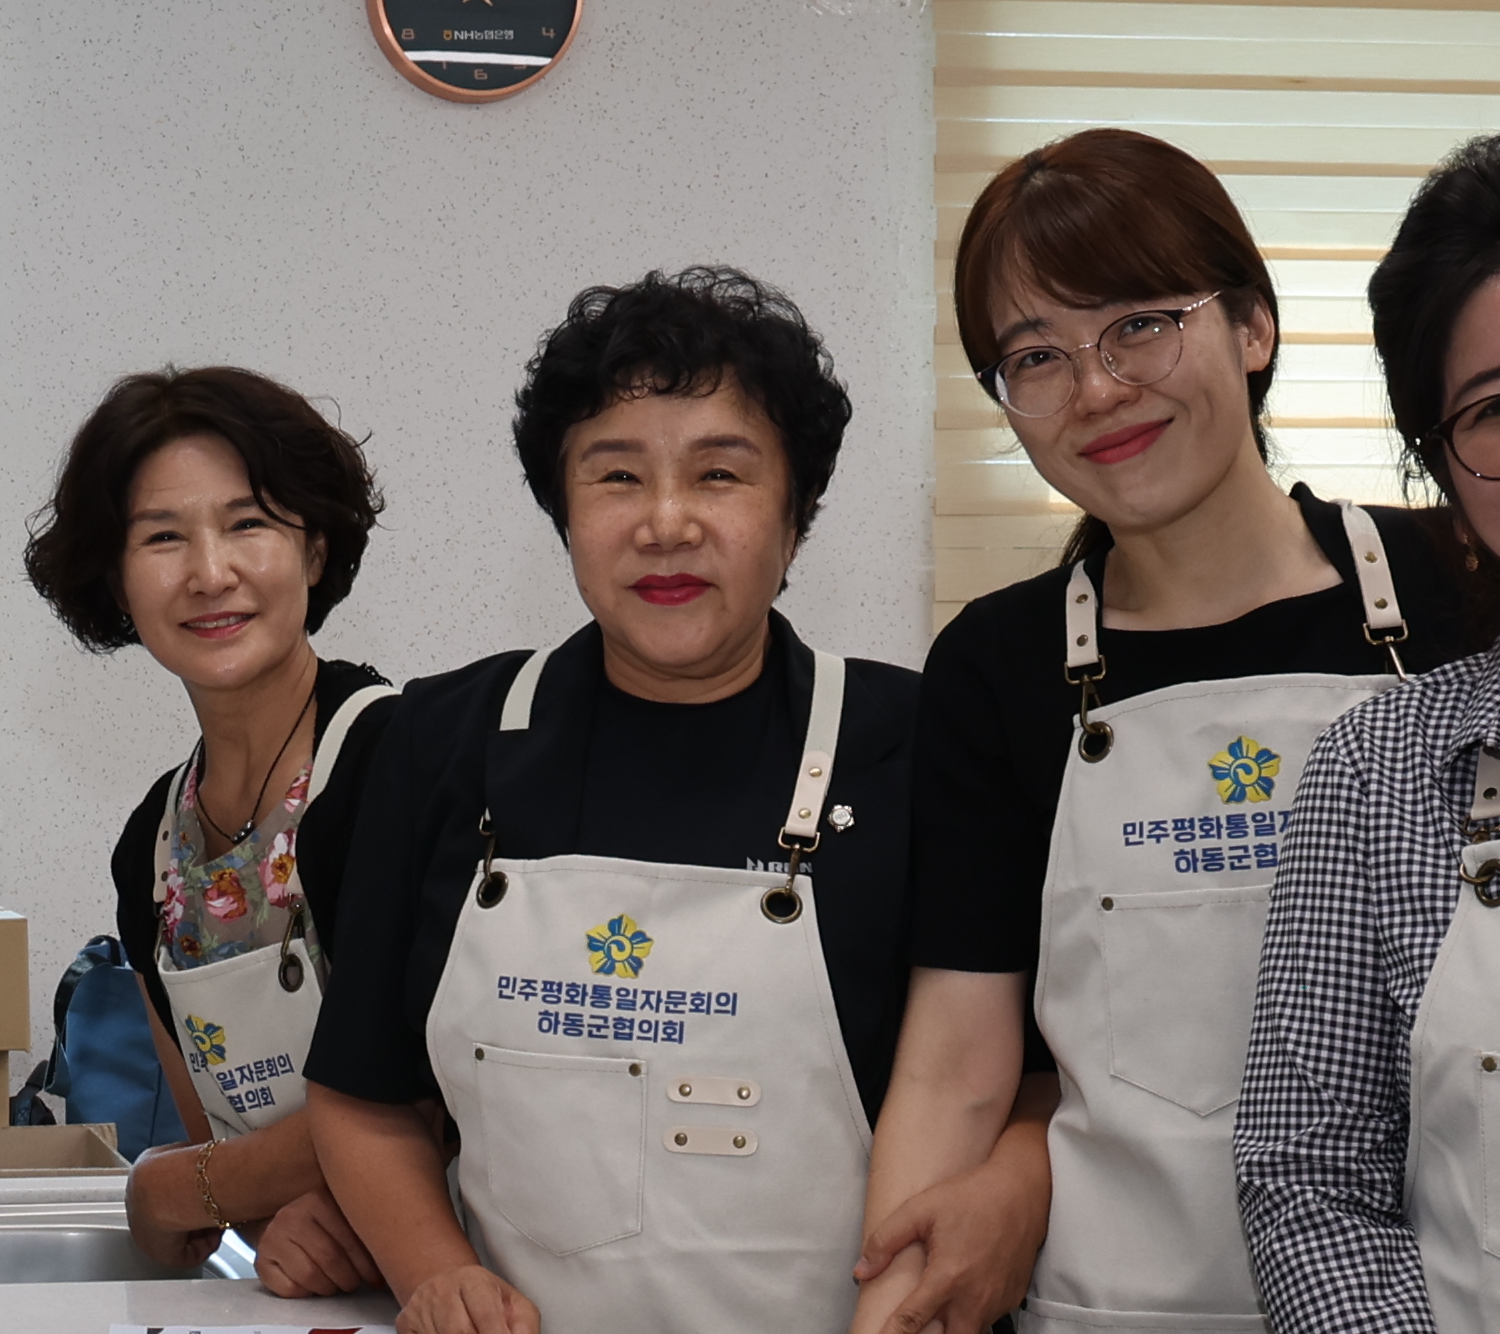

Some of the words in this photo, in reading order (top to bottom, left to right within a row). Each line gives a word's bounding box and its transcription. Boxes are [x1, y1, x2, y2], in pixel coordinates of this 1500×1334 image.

[1121, 810, 1294, 847] 민주평화통일
[1173, 843, 1278, 874] 하동군협
[497, 975, 739, 1017] 민주평화통일자문회의
[537, 1009, 686, 1045] 하동군협의회
[226, 1085, 276, 1114] 협의회
